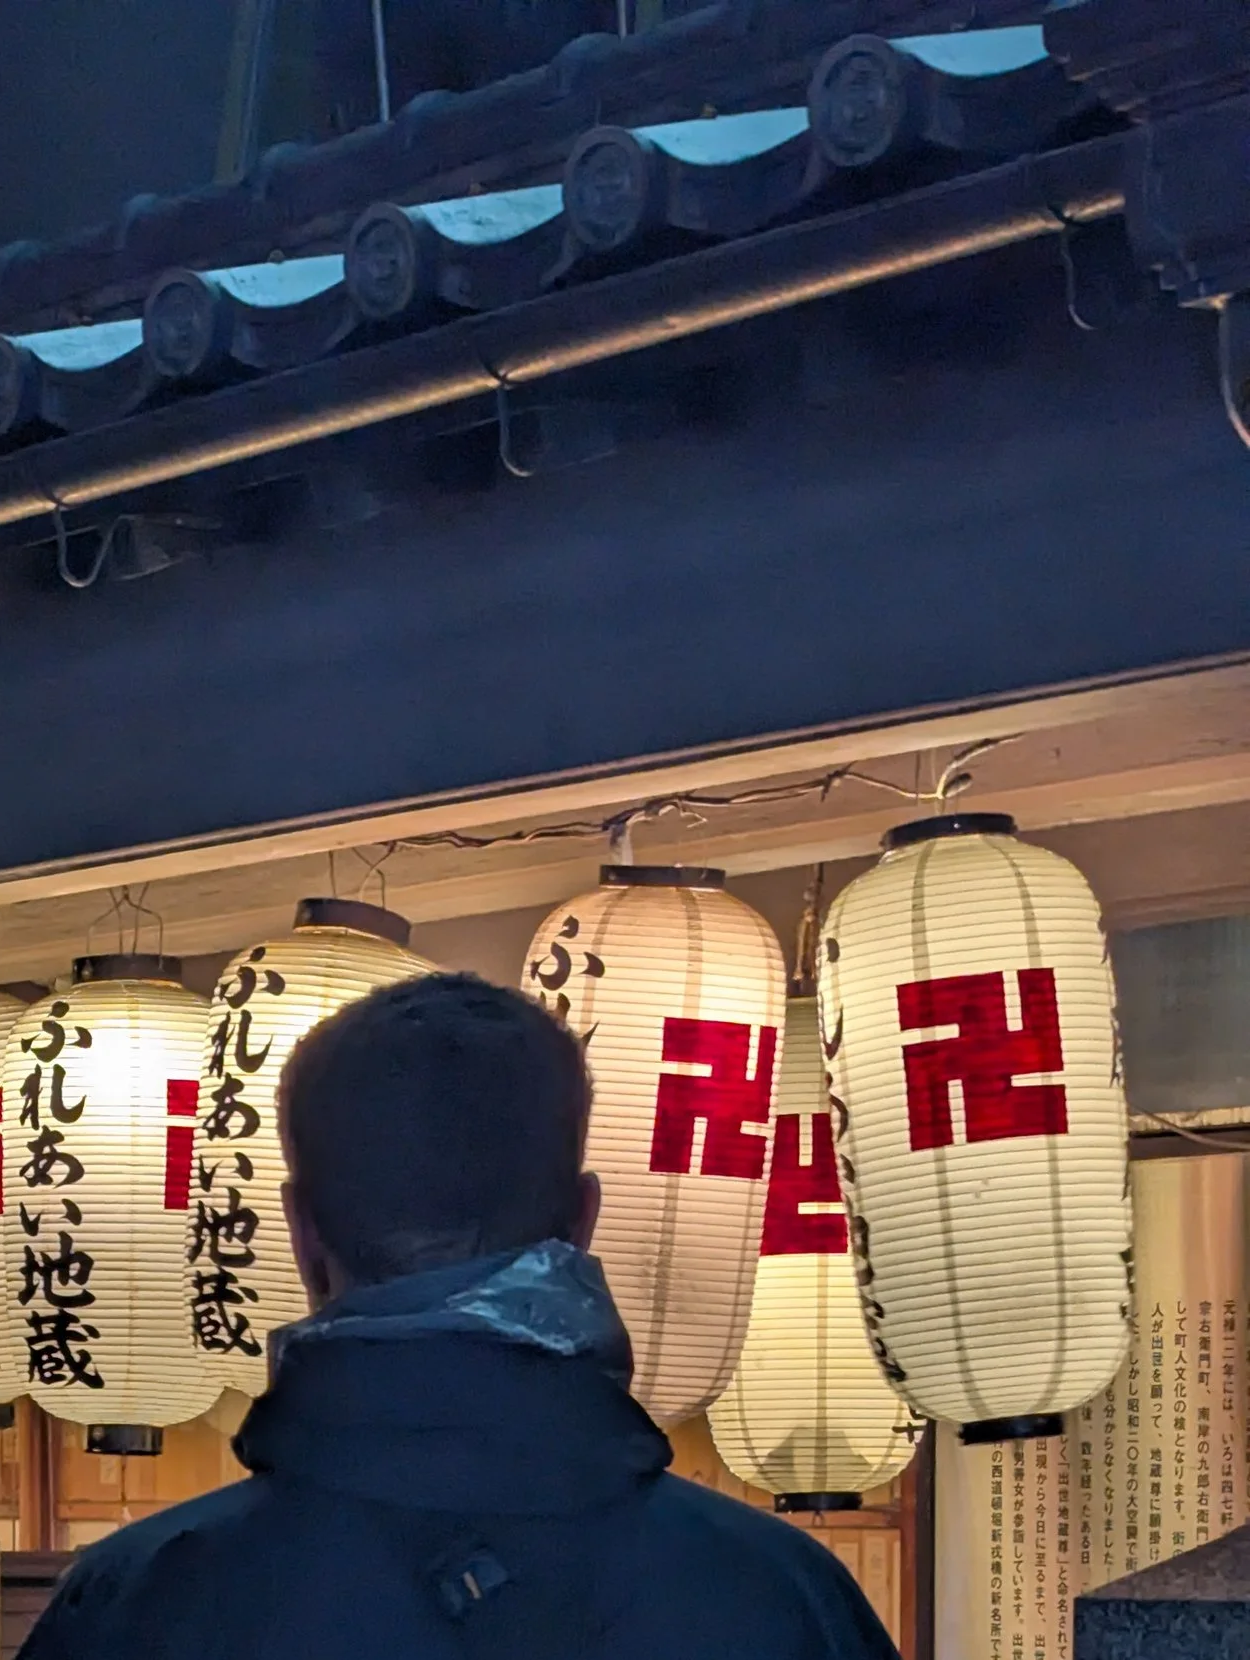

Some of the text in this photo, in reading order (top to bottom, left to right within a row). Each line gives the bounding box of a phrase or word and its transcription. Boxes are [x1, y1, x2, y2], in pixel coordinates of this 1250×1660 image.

[17, 1001, 105, 1389] ふれあい地蔵
[185, 945, 286, 1357] ふれあい地蔵
